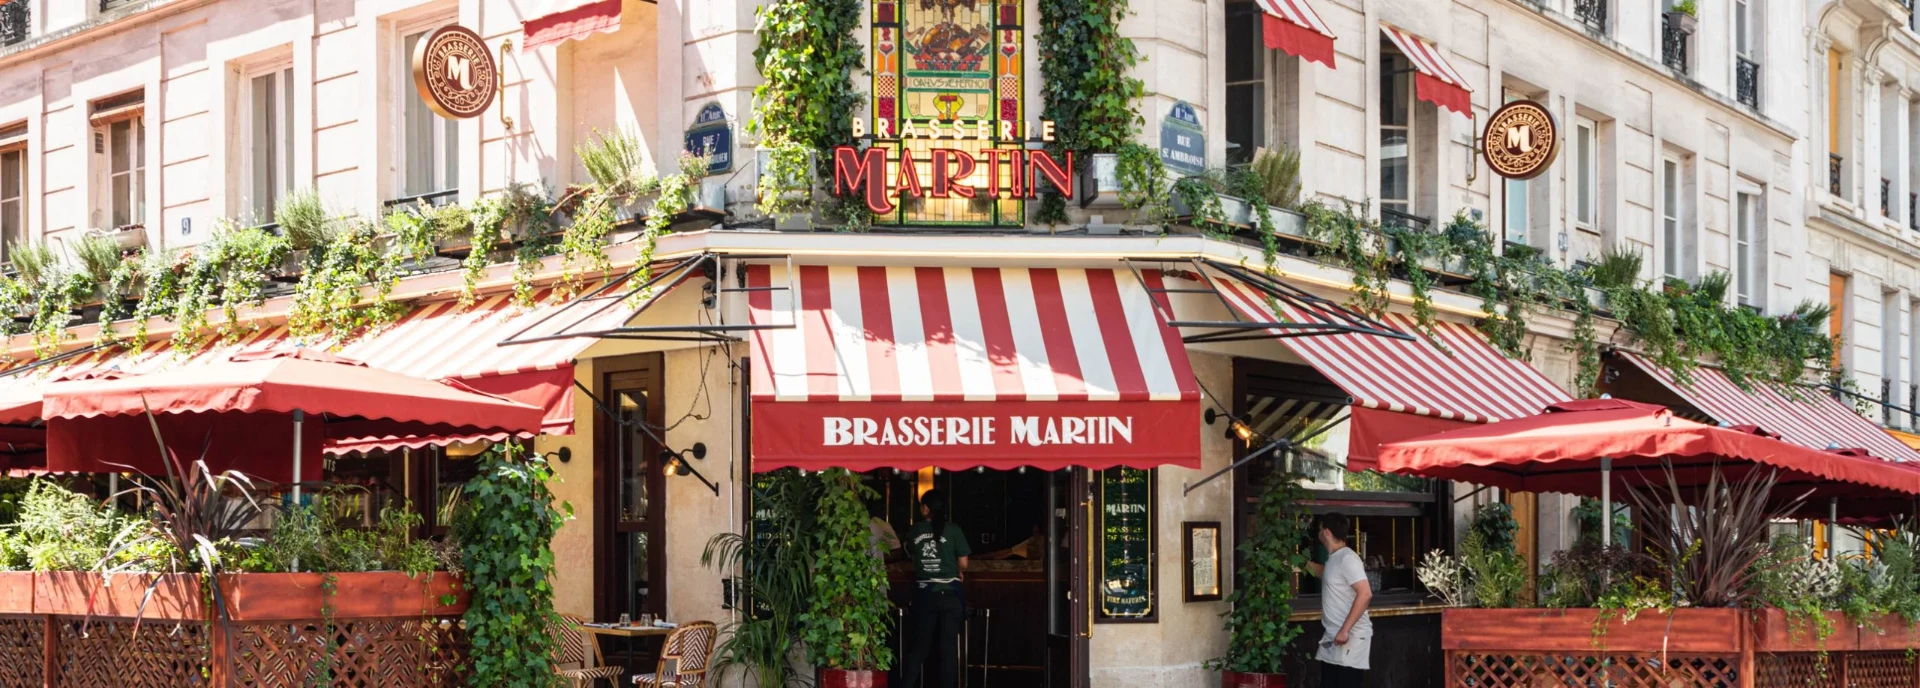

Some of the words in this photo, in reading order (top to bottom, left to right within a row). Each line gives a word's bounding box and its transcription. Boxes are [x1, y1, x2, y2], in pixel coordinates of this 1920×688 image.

[438, 41, 481, 65] BRASSERIE
[447, 55, 473, 90] M
[852, 117, 1055, 141] BRASSERIE
[1498, 113, 1540, 132] BRASSERIE
[703, 135, 714, 146] RUE
[1177, 135, 1191, 147] RUE
[1507, 125, 1533, 152] M
[1170, 150, 1204, 167] AMBROISE
[833, 145, 1073, 215] MARTIN
[183, 218, 189, 235] 9
[822, 416, 996, 446] BRASSERIE
[1010, 416, 1133, 446] MARTIN
[1106, 504, 1146, 515] MARTIN
